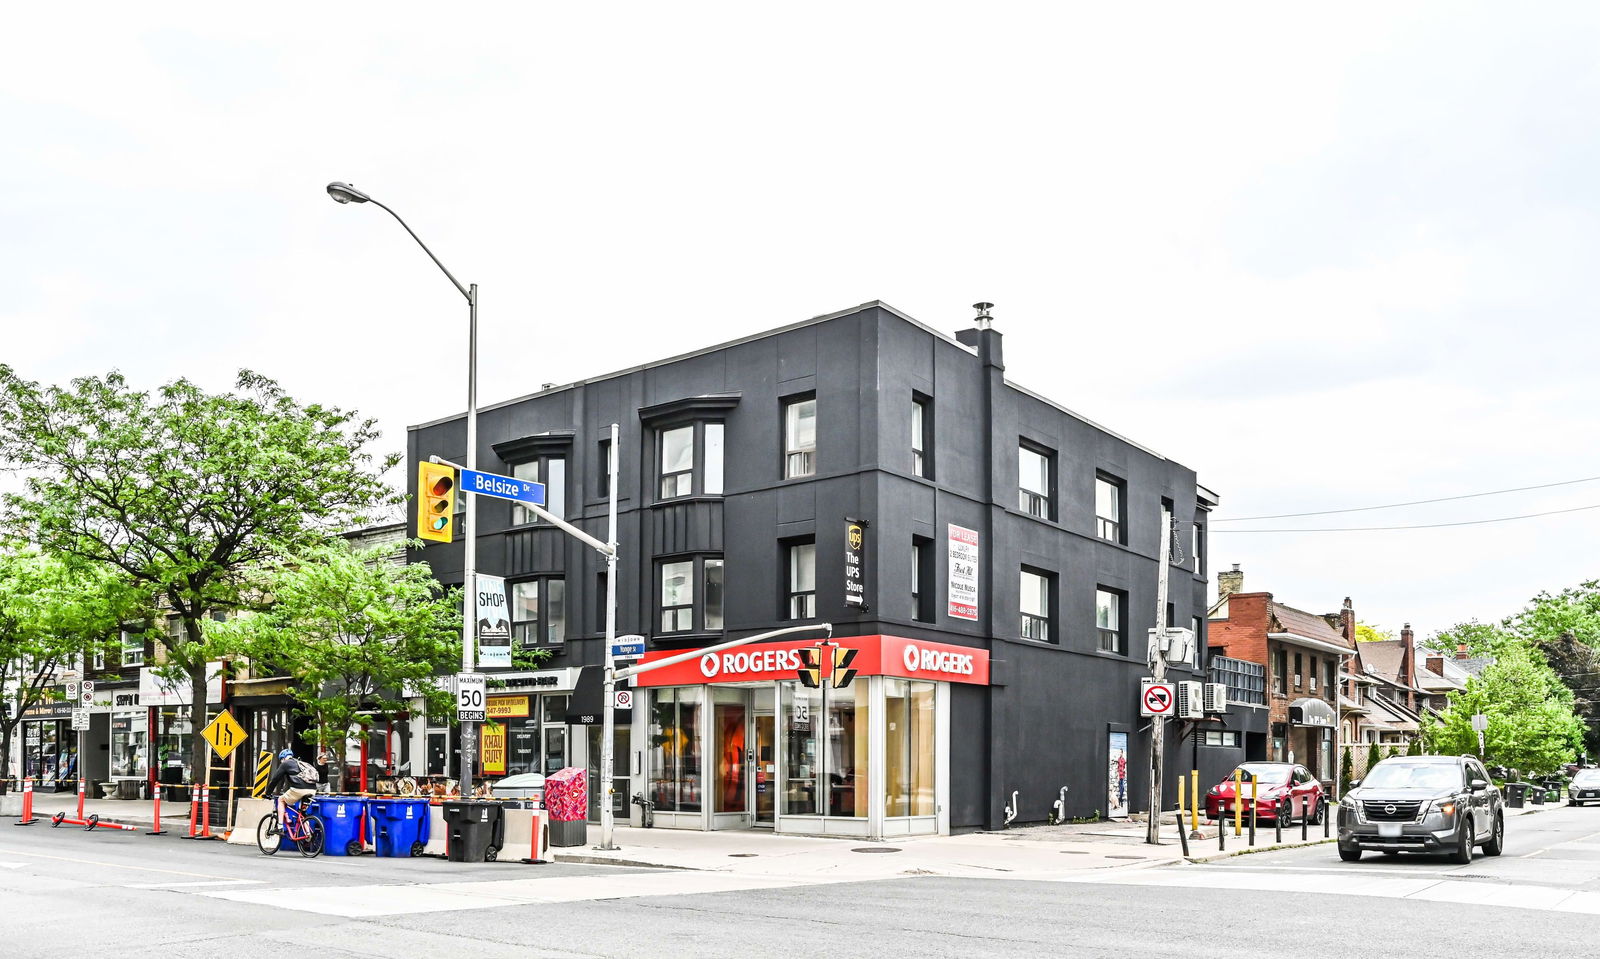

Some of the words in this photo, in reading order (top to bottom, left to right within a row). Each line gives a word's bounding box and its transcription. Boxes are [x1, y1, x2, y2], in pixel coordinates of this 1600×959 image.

[476, 475, 519, 496] Belsize
[523, 484, 531, 492] Dr
[846, 551, 859, 565] The
[846, 566, 860, 578] UPS
[846, 580, 864, 593] Store
[479, 592, 505, 607] SHOP
[722, 648, 800, 674] ROGERS
[920, 651, 974, 675] ROGERS
[461, 690, 482, 707] 50
[460, 711, 484, 720] BEGINS
[581, 715, 594, 723] 1989
[484, 735, 503, 748] KHAU
